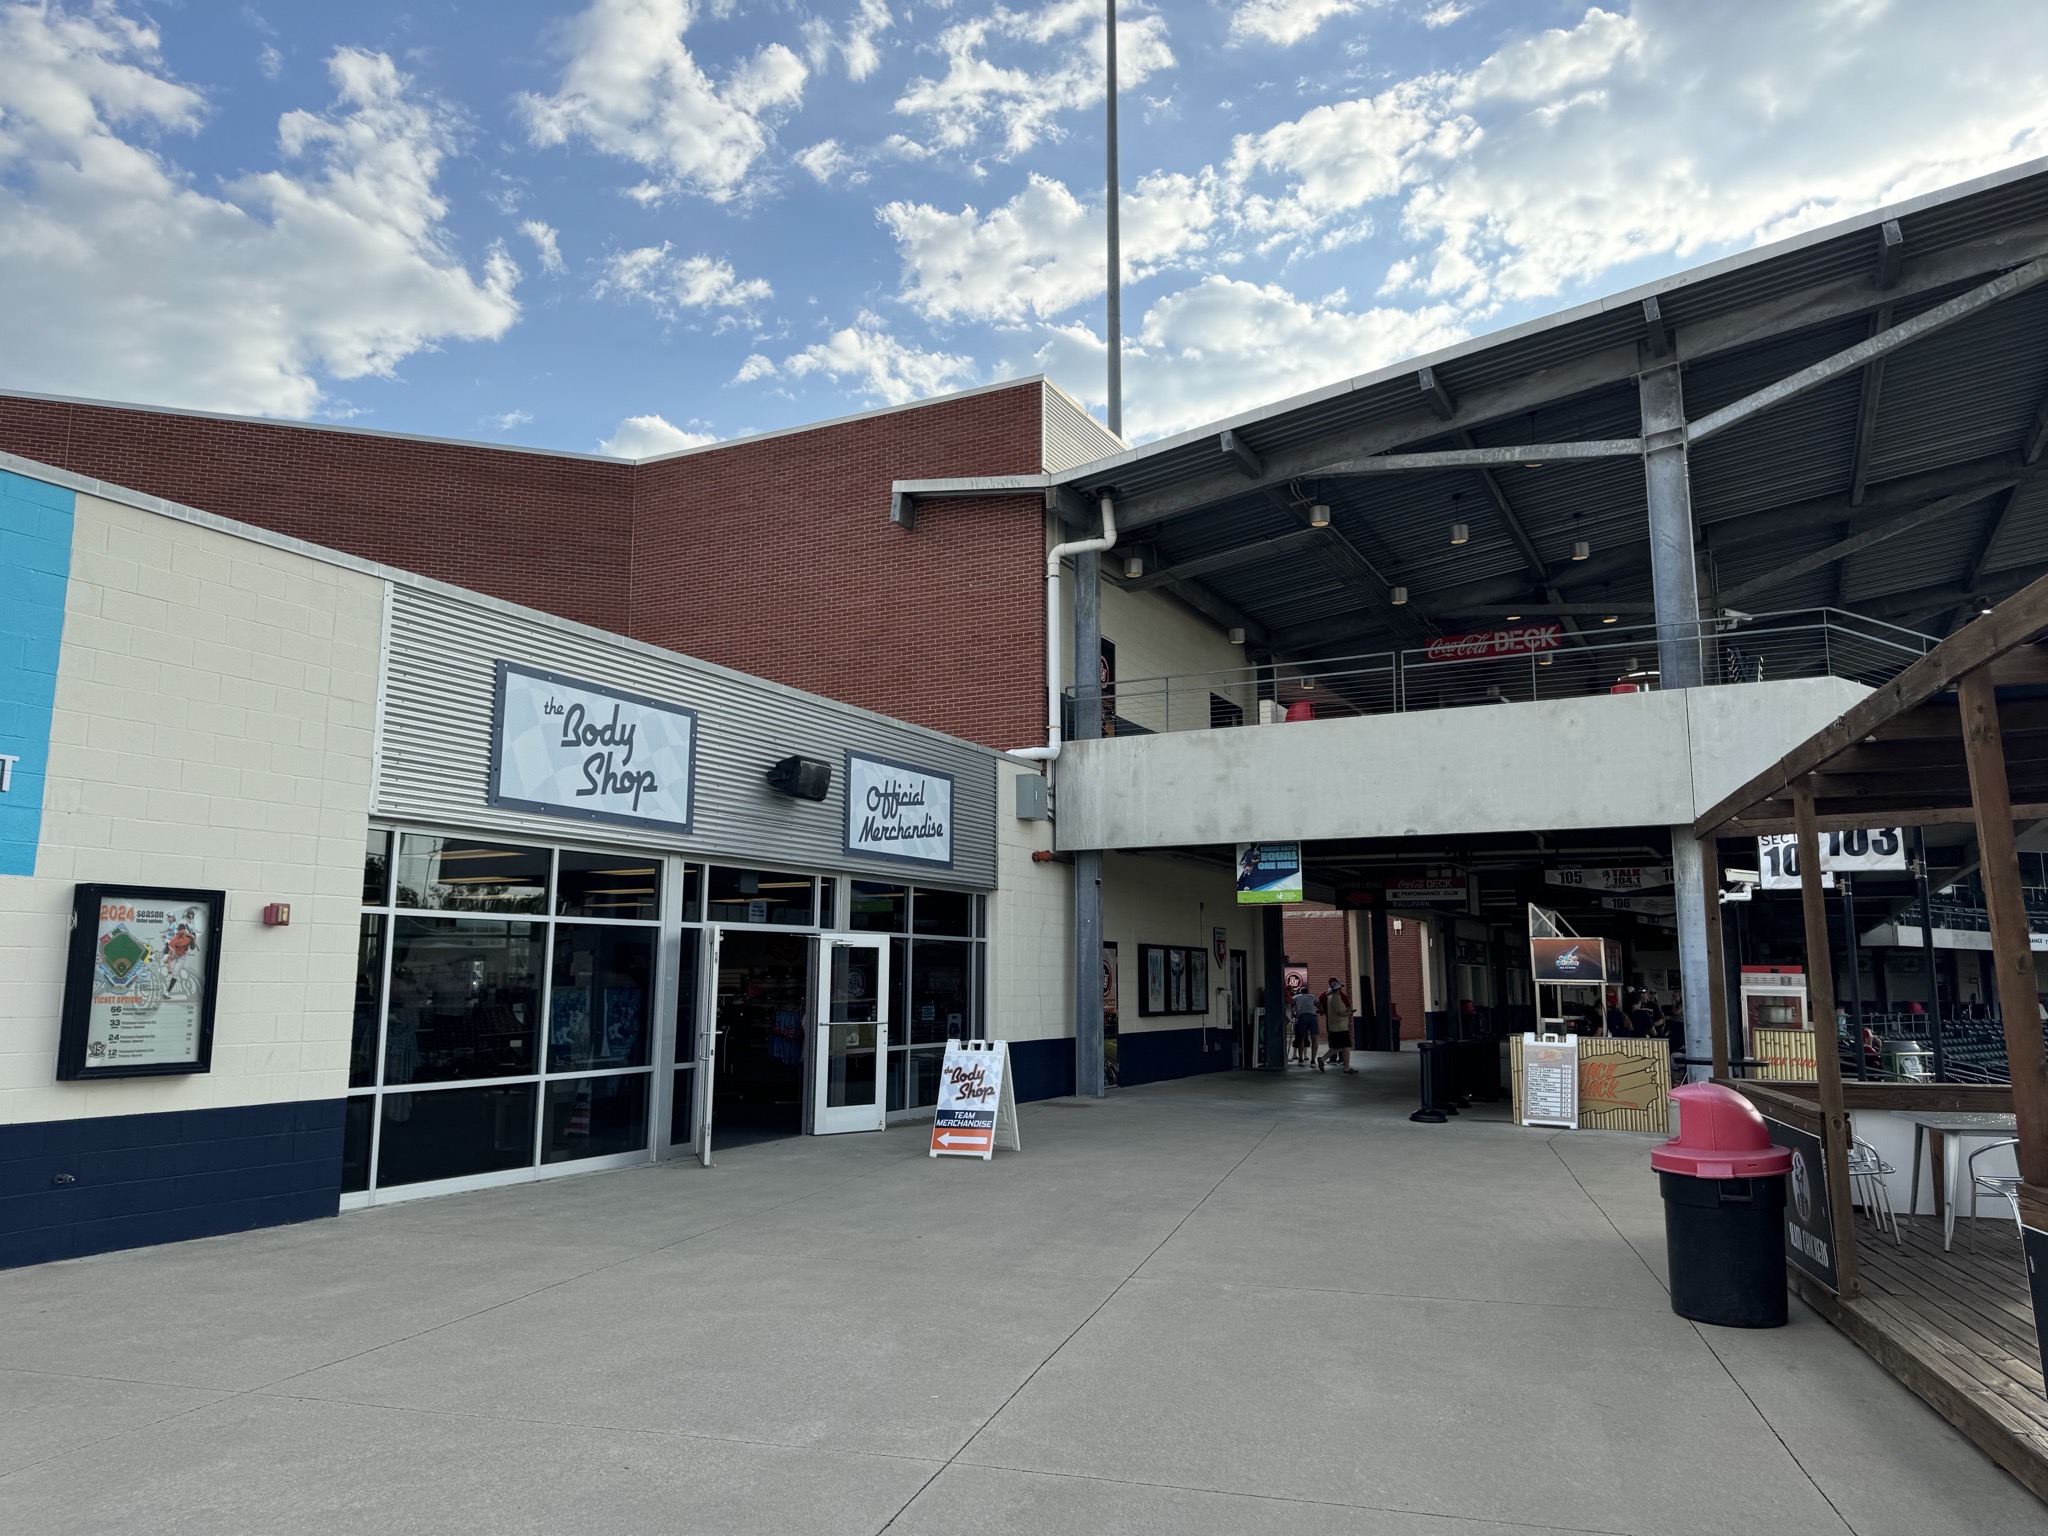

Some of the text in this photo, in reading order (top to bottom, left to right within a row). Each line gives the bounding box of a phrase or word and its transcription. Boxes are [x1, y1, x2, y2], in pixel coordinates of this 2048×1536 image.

[1494, 626, 1559, 652] DECK
[544, 696, 636, 766] the Body
[575, 751, 658, 812] Shop
[866, 779, 925, 818] Official
[858, 813, 943, 844] Merchandise
[1761, 834, 1798, 846] SECT
[1261, 851, 1298, 861] EQUAL
[1257, 861, 1298, 870] ONE MILE
[1558, 871, 1582, 884] 105
[1611, 868, 1641, 877] TALK
[1426, 878, 1453, 888] DECK
[1612, 876, 1641, 884] 104.1
[1611, 898, 1630, 908] 106
[100, 904, 164, 922] 2024 season
[94, 996, 143, 1004] TICKET OPTIONS
[944, 1063, 986, 1087] the Body
[955, 1082, 996, 1104] Shop
[954, 1111, 976, 1119] TEAM
[936, 1119, 993, 1128] MERCHANDISE
